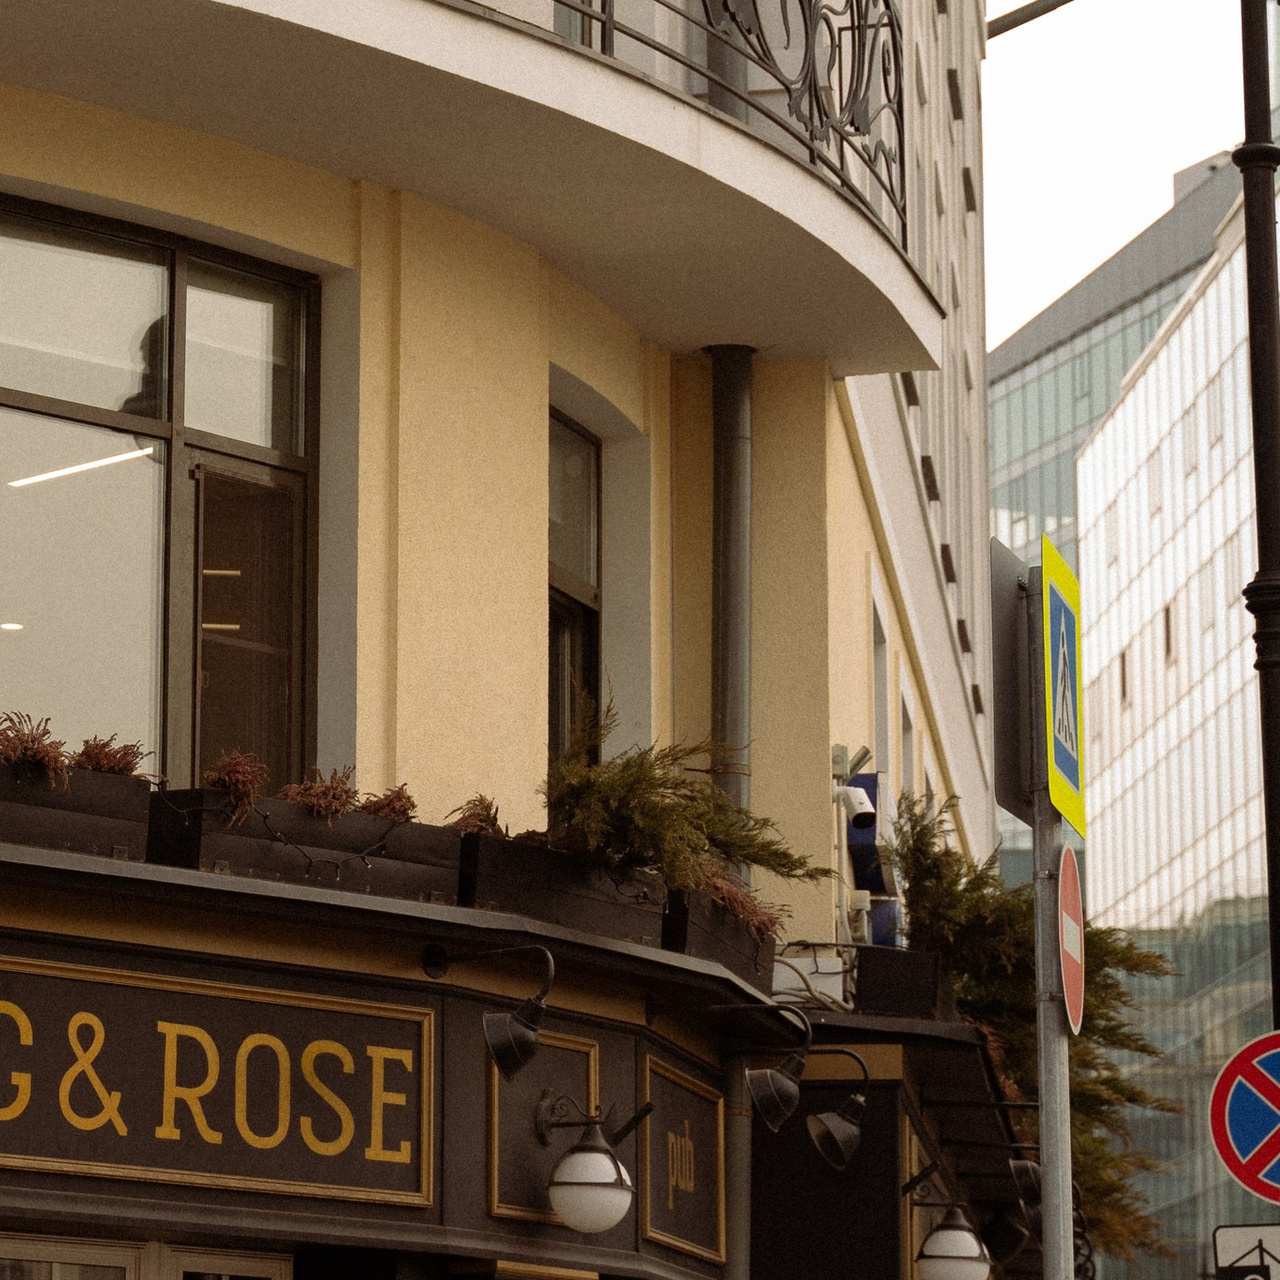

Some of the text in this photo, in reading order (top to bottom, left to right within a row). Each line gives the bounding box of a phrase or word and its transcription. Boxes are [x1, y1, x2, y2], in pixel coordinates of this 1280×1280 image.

[58, 1011, 128, 1136] &
[154, 1020, 414, 1164] ROSE
[667, 1119, 695, 1210] pub
